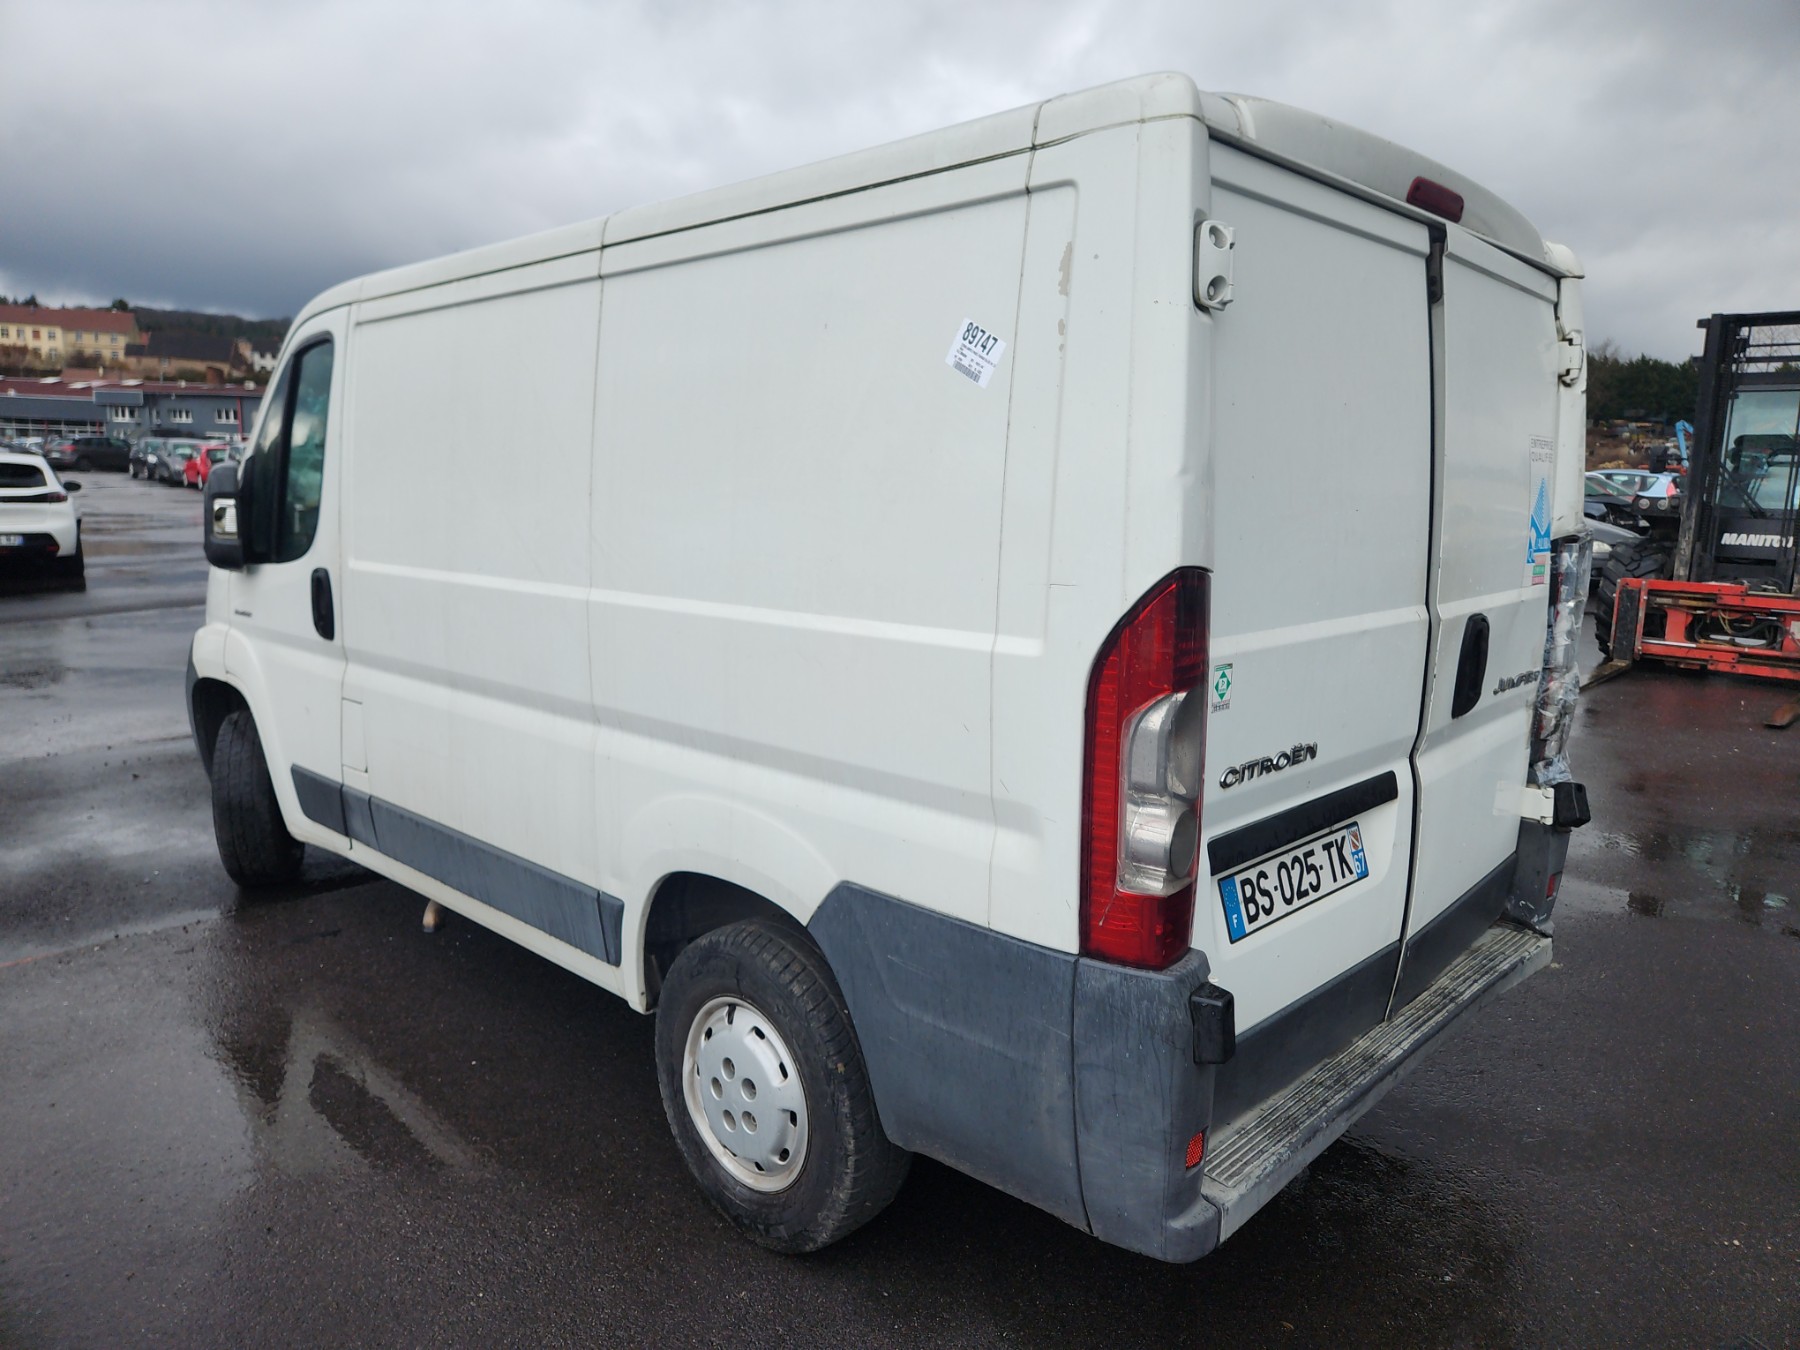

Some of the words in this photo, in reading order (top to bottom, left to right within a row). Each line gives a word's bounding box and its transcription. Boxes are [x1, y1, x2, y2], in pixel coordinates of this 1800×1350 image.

[962, 322, 998, 356] 89747
[1219, 742, 1318, 789] CITROËN
[1232, 914, 1239, 928] F
[1353, 851, 1365, 874] 67
